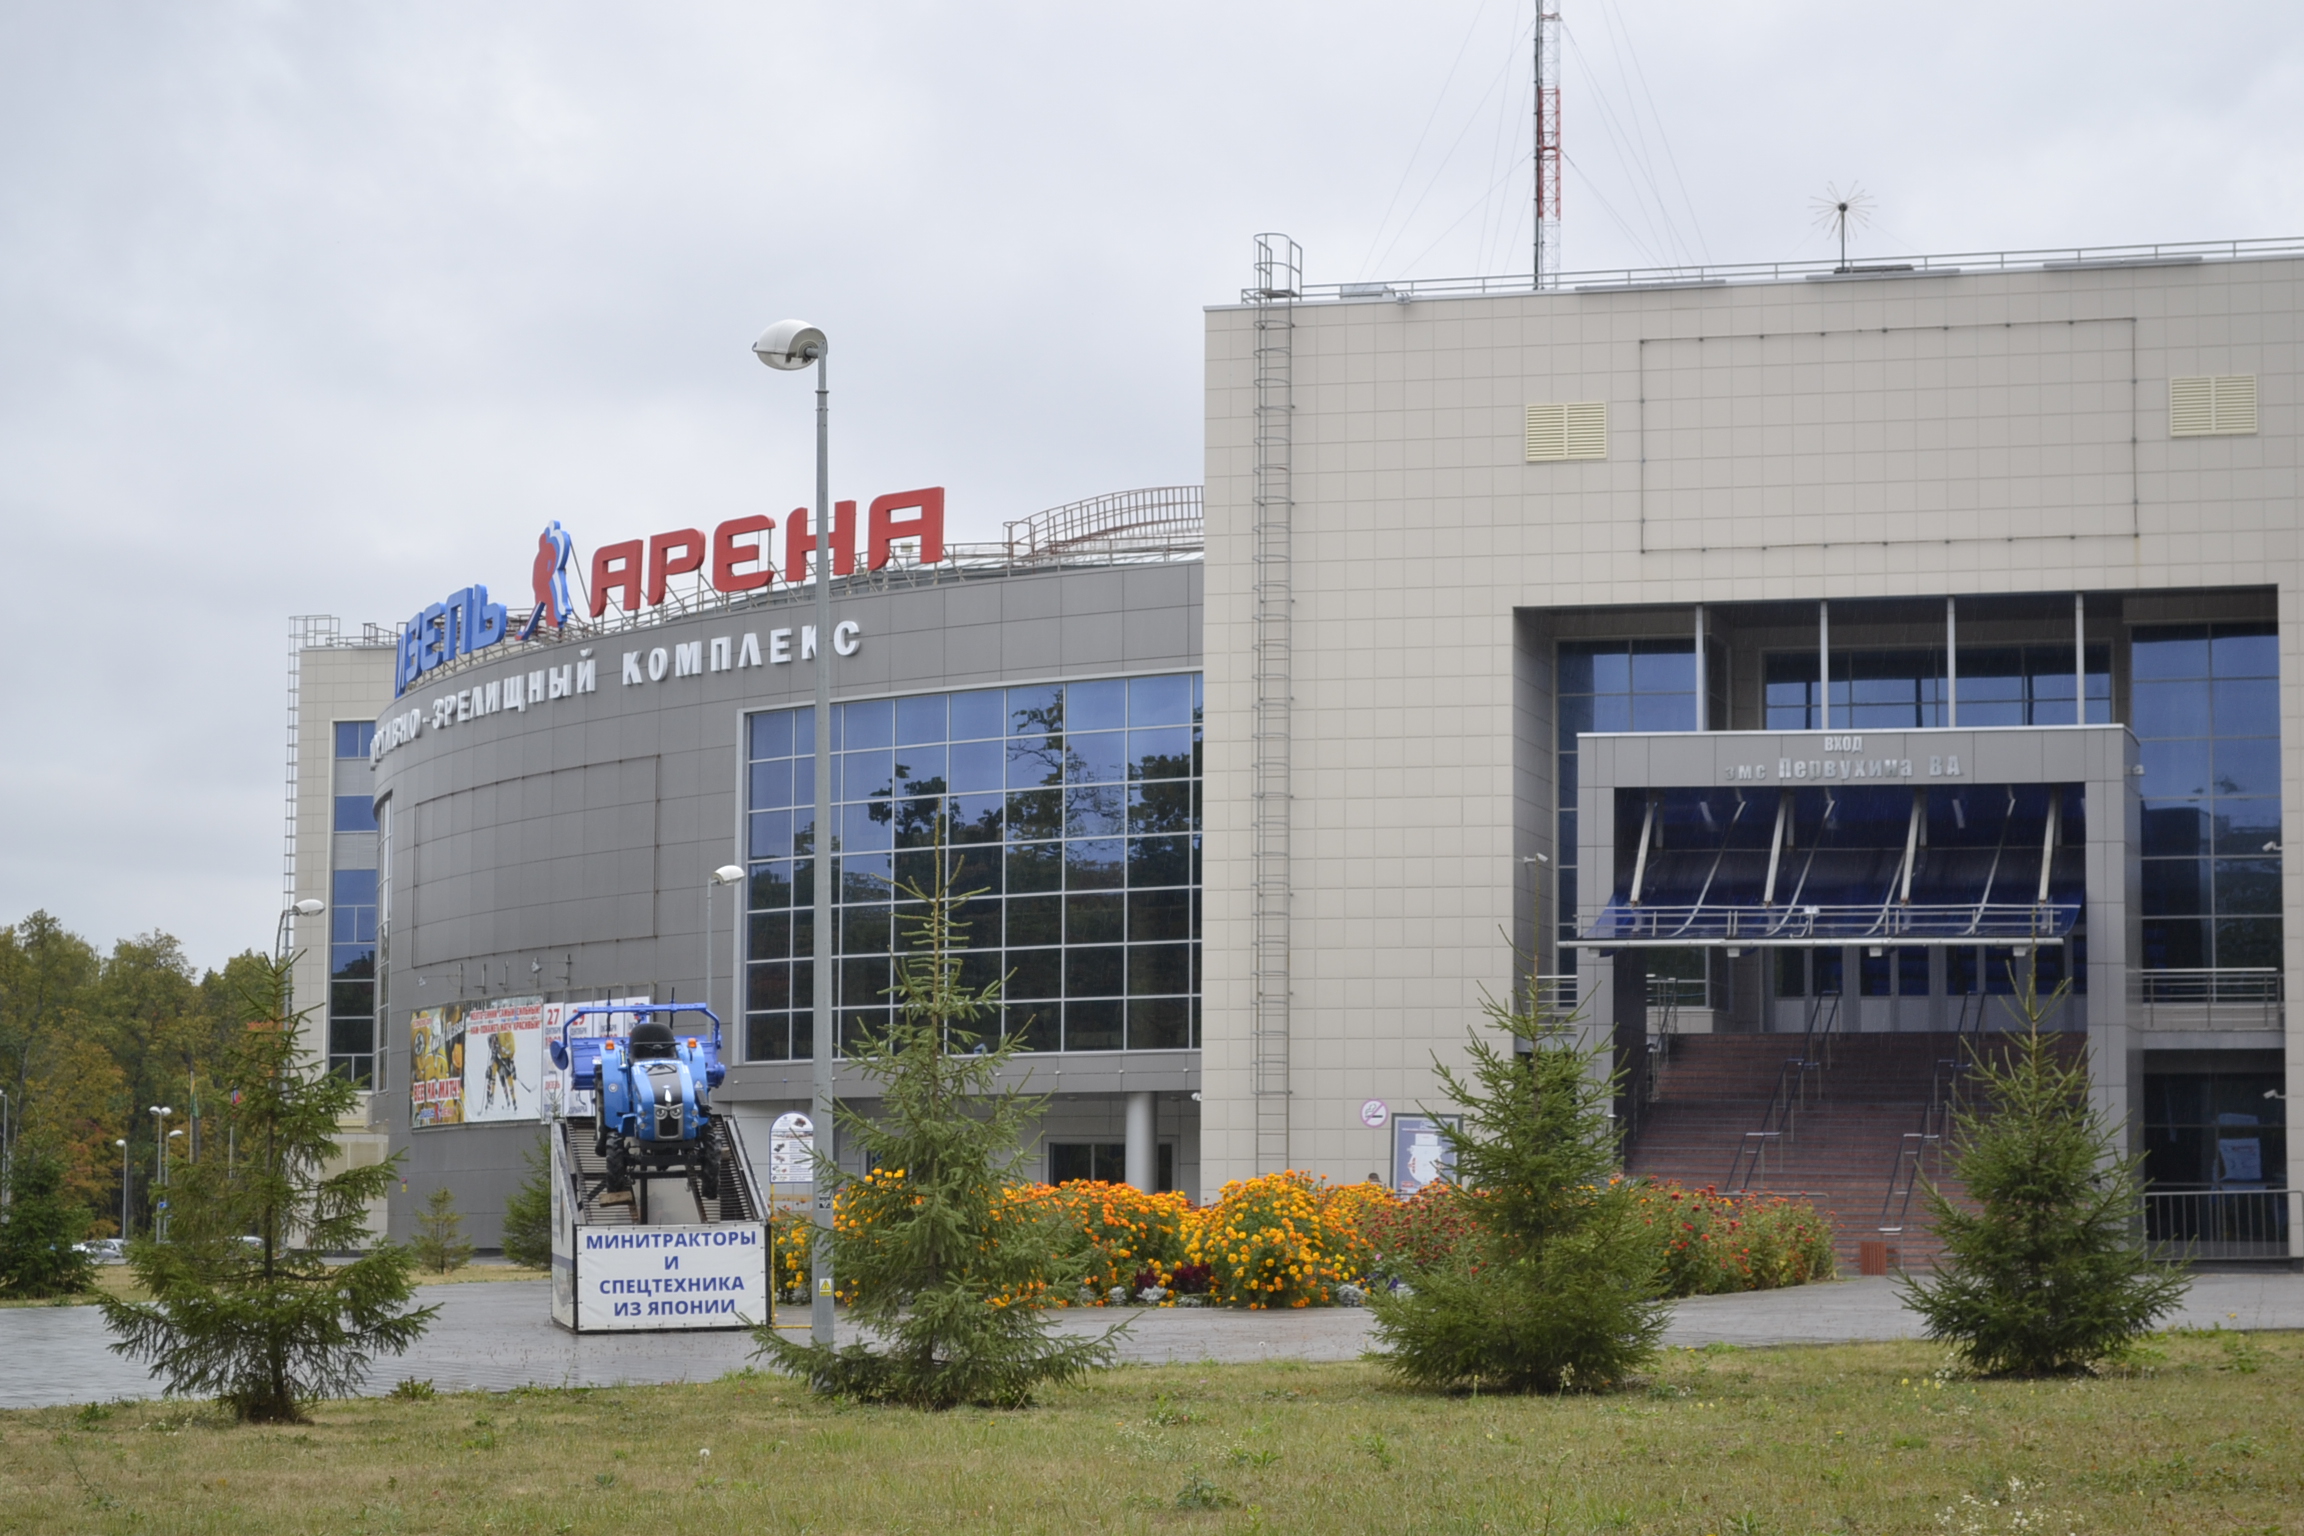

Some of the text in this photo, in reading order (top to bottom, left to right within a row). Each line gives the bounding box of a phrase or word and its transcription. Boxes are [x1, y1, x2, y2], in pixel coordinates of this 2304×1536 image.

[590, 486, 945, 618] АРЕНА
[622, 620, 860, 686] КОМПЛЕКС
[1824, 736, 1863, 753] ВХОД
[547, 1008, 560, 1025] 27
[586, 1231, 756, 1250] МИНИТРАКТОРЫ
[664, 1256, 679, 1270] И
[599, 1276, 745, 1297] СПЕЦТЕХНИКА
[614, 1299, 735, 1317] ИЗ ЯПОНИИ
